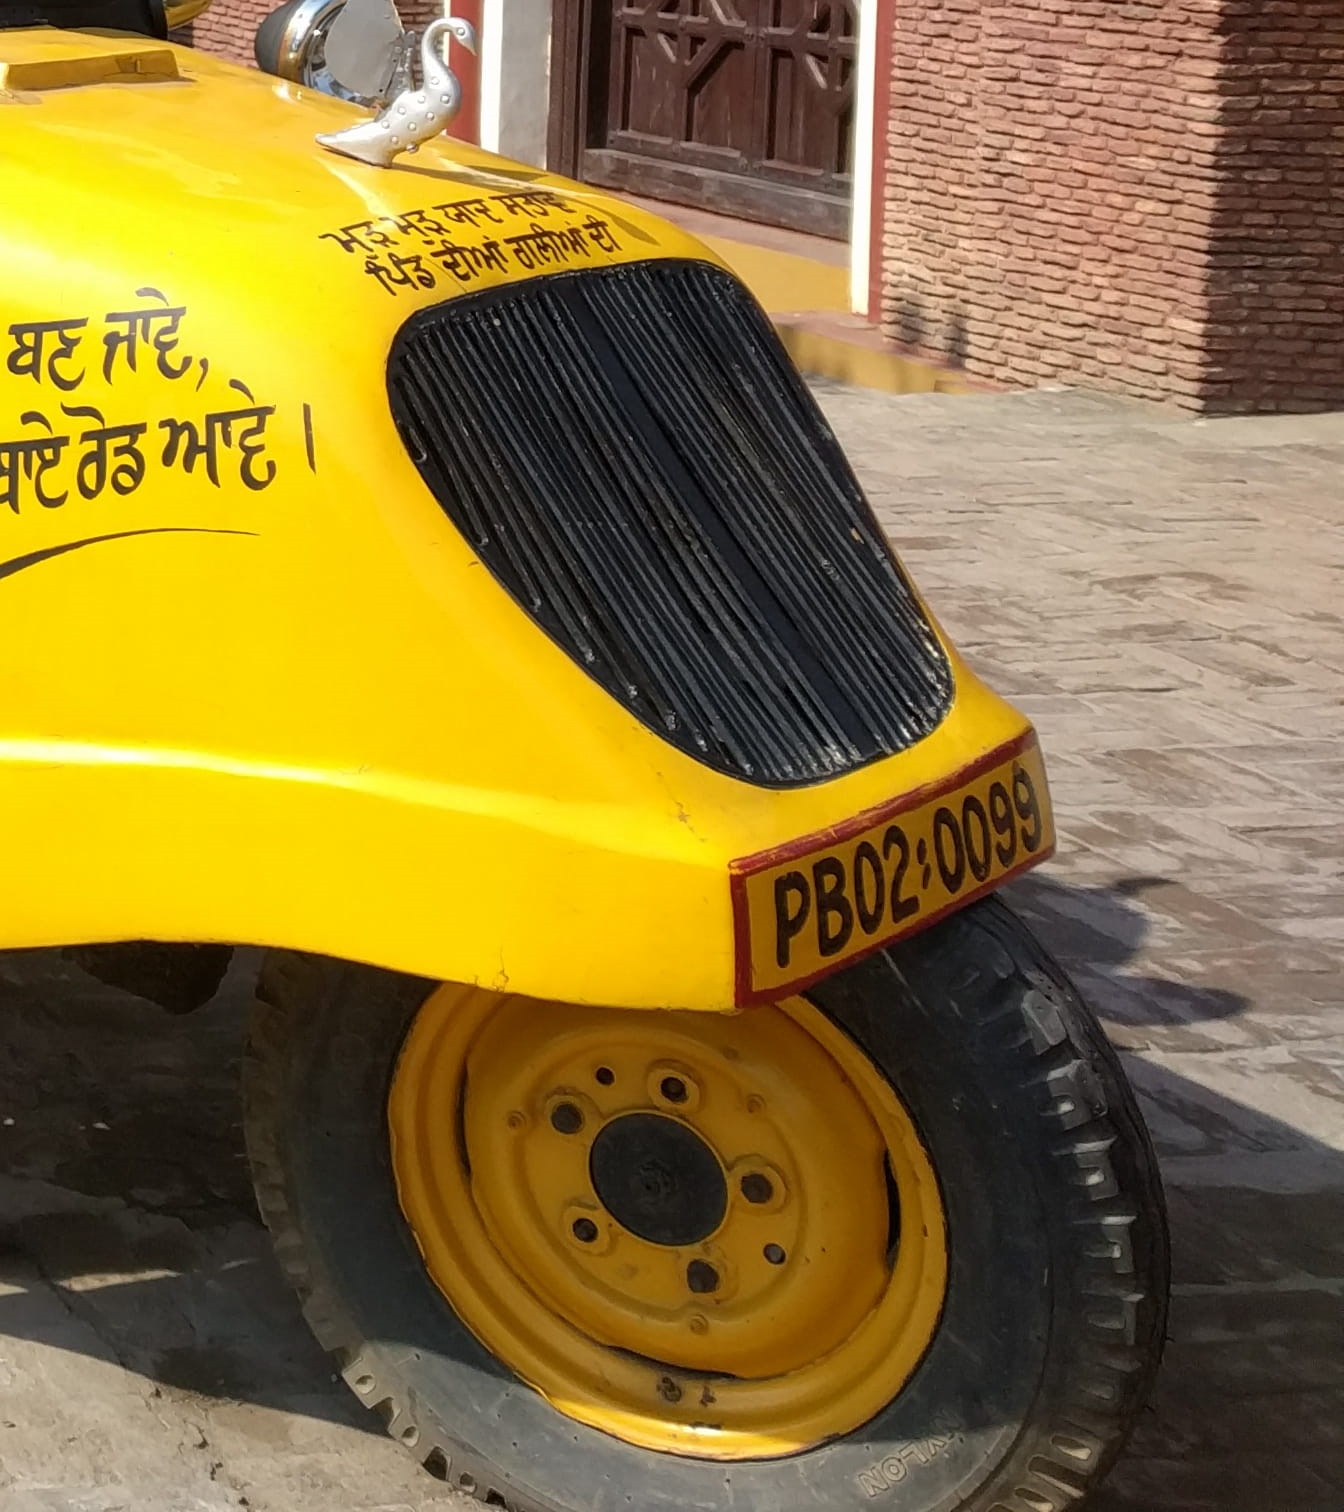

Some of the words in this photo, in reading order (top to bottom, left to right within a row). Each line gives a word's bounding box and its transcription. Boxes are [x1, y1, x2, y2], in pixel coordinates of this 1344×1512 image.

[582, 214, 623, 252] ਦੀ
[7, 317, 89, 391] ਬਣ
[61, 401, 148, 500] ਰੋਡ
